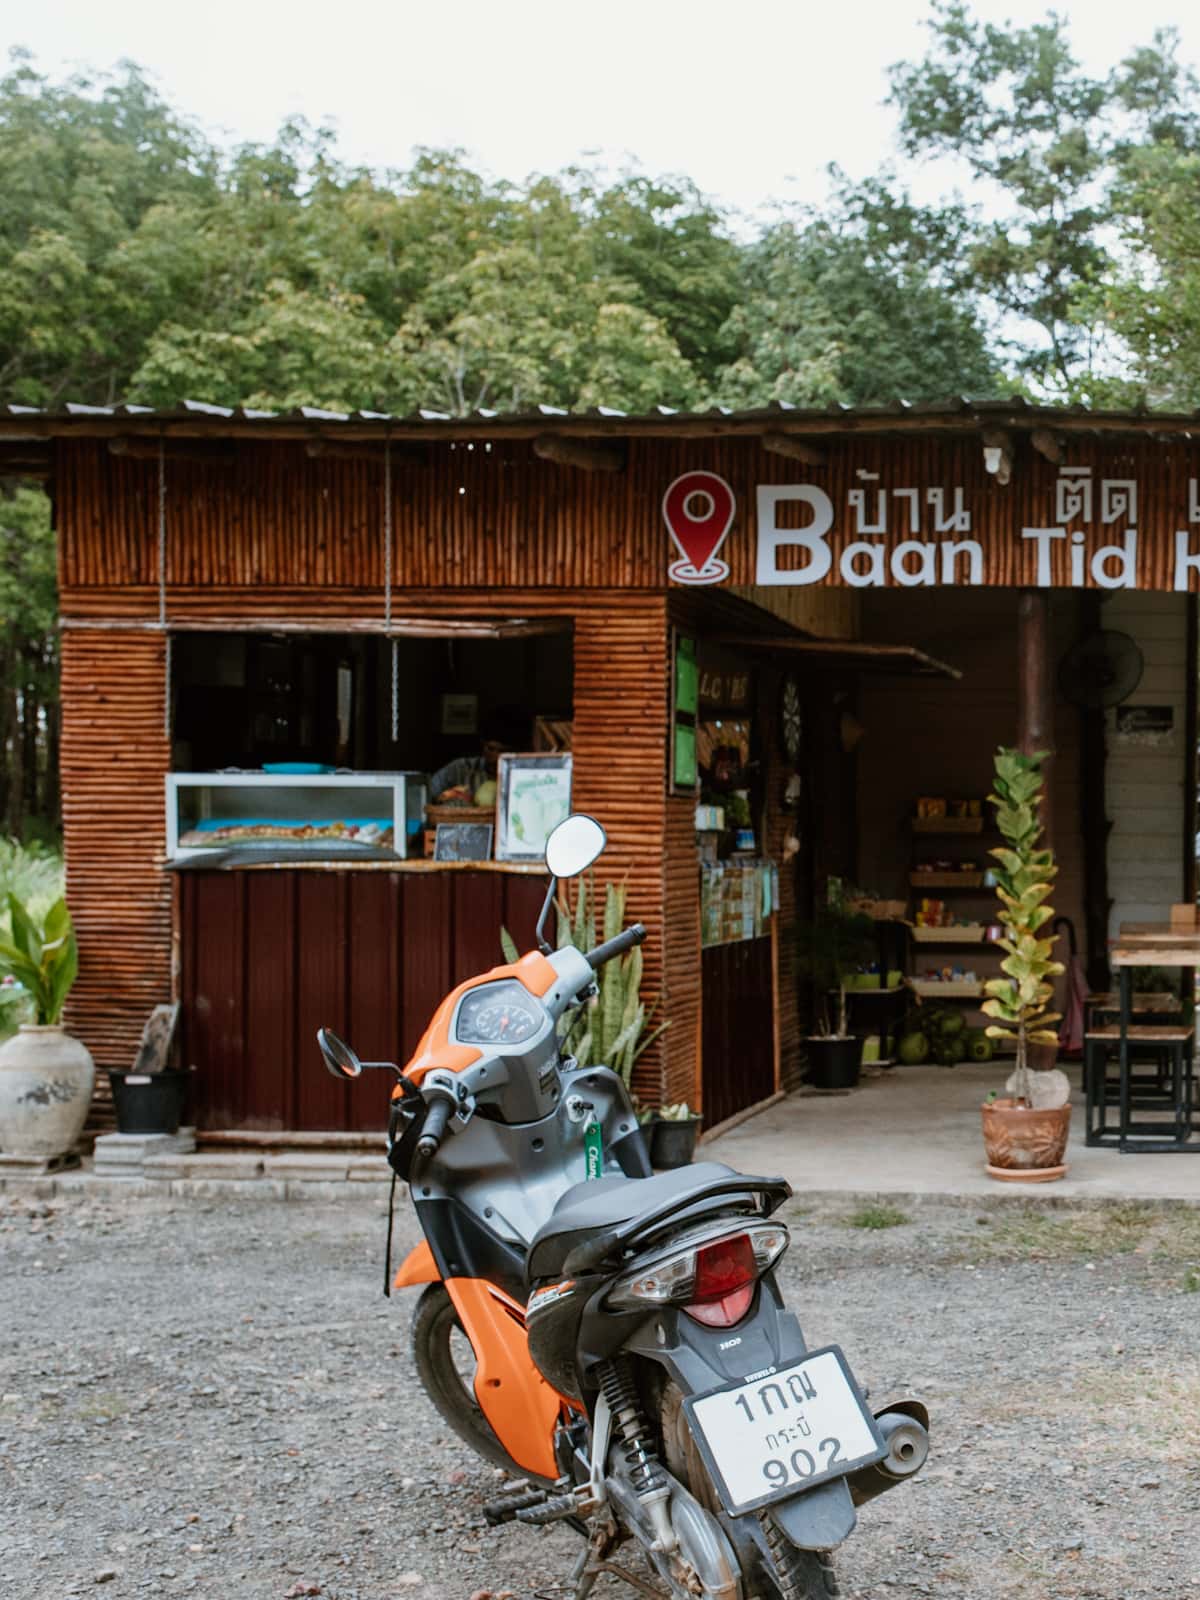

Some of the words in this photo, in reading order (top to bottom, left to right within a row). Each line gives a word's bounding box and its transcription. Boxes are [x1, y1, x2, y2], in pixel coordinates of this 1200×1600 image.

[848, 469, 971, 534] บ้าน
[1056, 467, 1137, 524] ติด
[756, 484, 983, 587] Baan
[1021, 527, 1137, 588] Tid
[764, 1410, 812, 1450] กระบี่
[762, 1437, 848, 1489] 902
